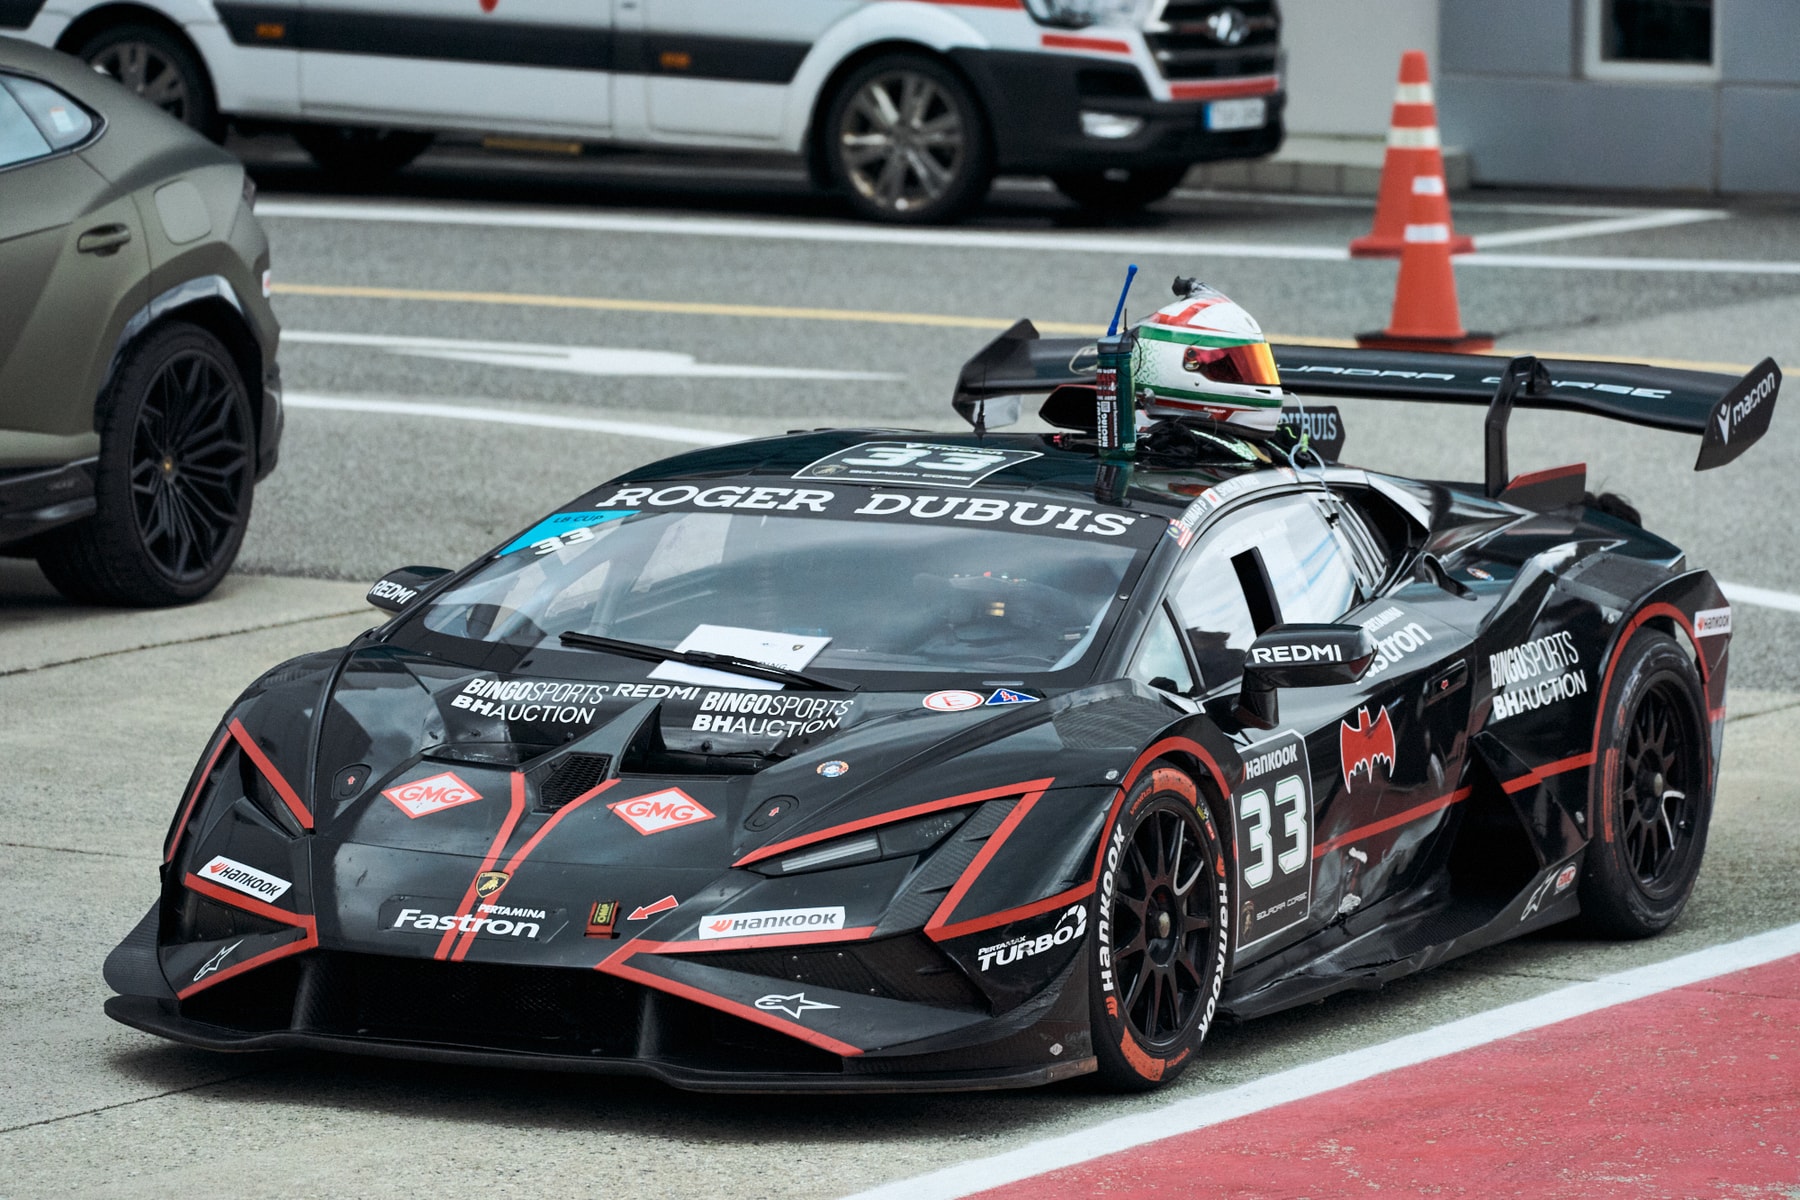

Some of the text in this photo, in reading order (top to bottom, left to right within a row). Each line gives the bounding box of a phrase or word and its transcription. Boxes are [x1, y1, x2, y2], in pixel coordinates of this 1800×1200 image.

[1276, 364, 1672, 400] UADRA CRSE
[1732, 371, 1775, 426] macron
[842, 447, 1007, 472] 33
[572, 514, 604, 523] CUP
[596, 485, 1135, 537] ROGER DUBUIS
[530, 526, 596, 556] 33
[370, 579, 417, 605] REDMI
[1252, 643, 1342, 665] REDMI
[1356, 622, 1433, 685] astron
[612, 682, 700, 701] REDMI
[398, 785, 466, 805] GMG
[624, 800, 696, 823] GMG
[1240, 774, 1308, 890] 33
[393, 908, 541, 939] Fastron
[477, 903, 546, 920] PERTAMINA
[596, 903, 610, 923] OMP
[977, 925, 1074, 972] TURBO
